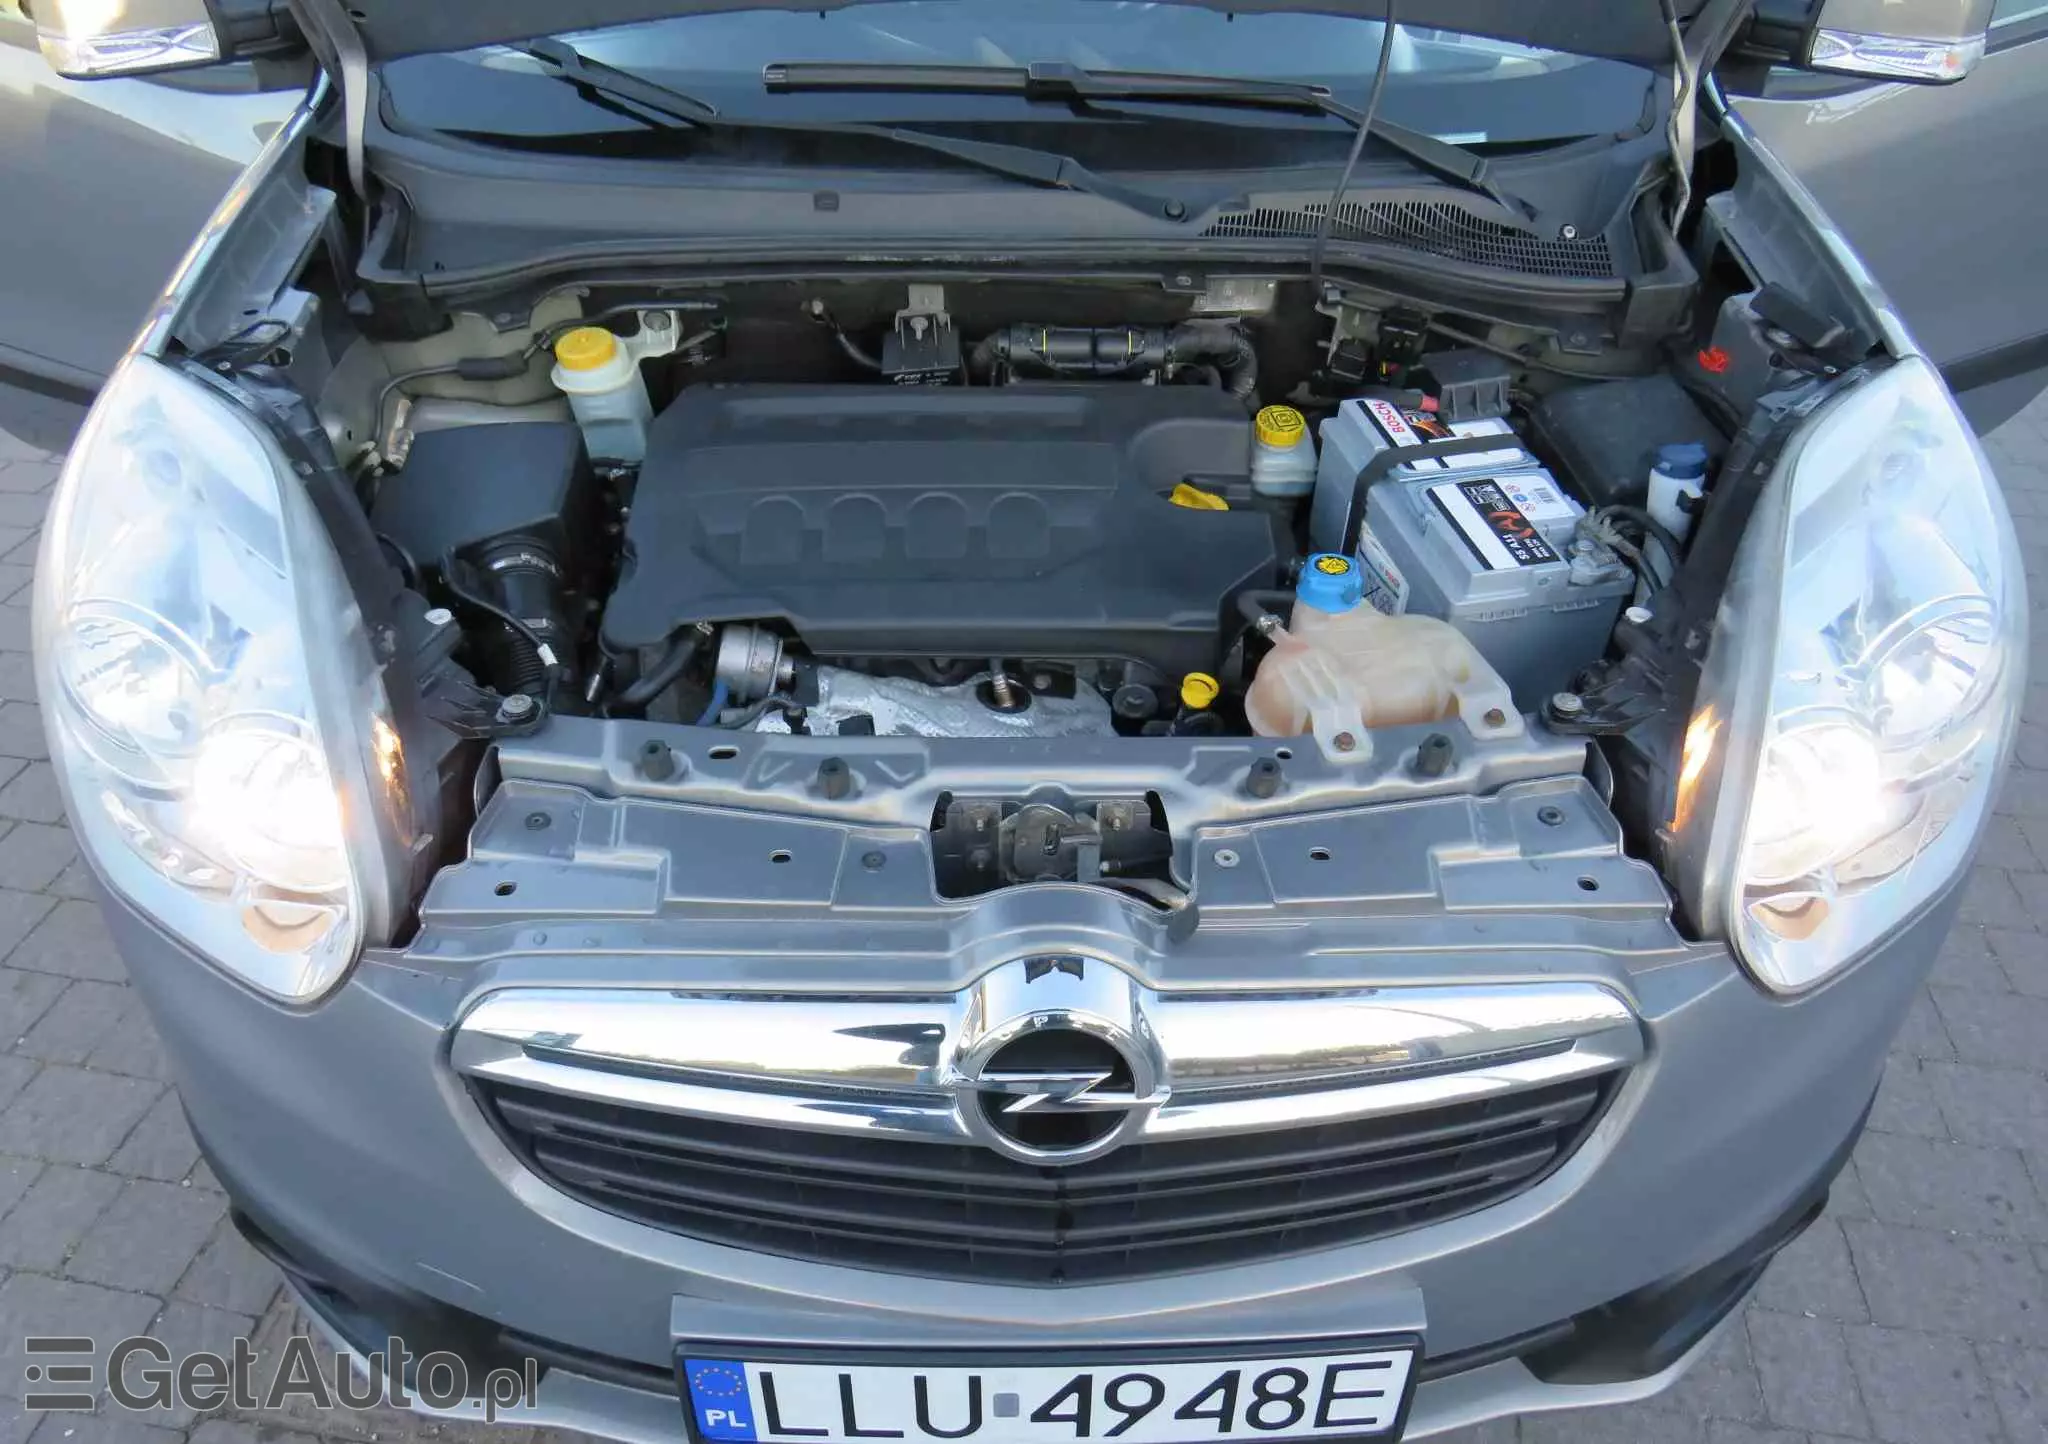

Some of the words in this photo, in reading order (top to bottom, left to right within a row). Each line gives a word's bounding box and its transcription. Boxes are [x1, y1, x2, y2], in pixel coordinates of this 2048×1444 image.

[1374, 400, 1405, 432] BOSCH
[759, 1371, 982, 1438] LLU
[1030, 1360, 1393, 1438] 4948E
[705, 1409, 747, 1428] PL
